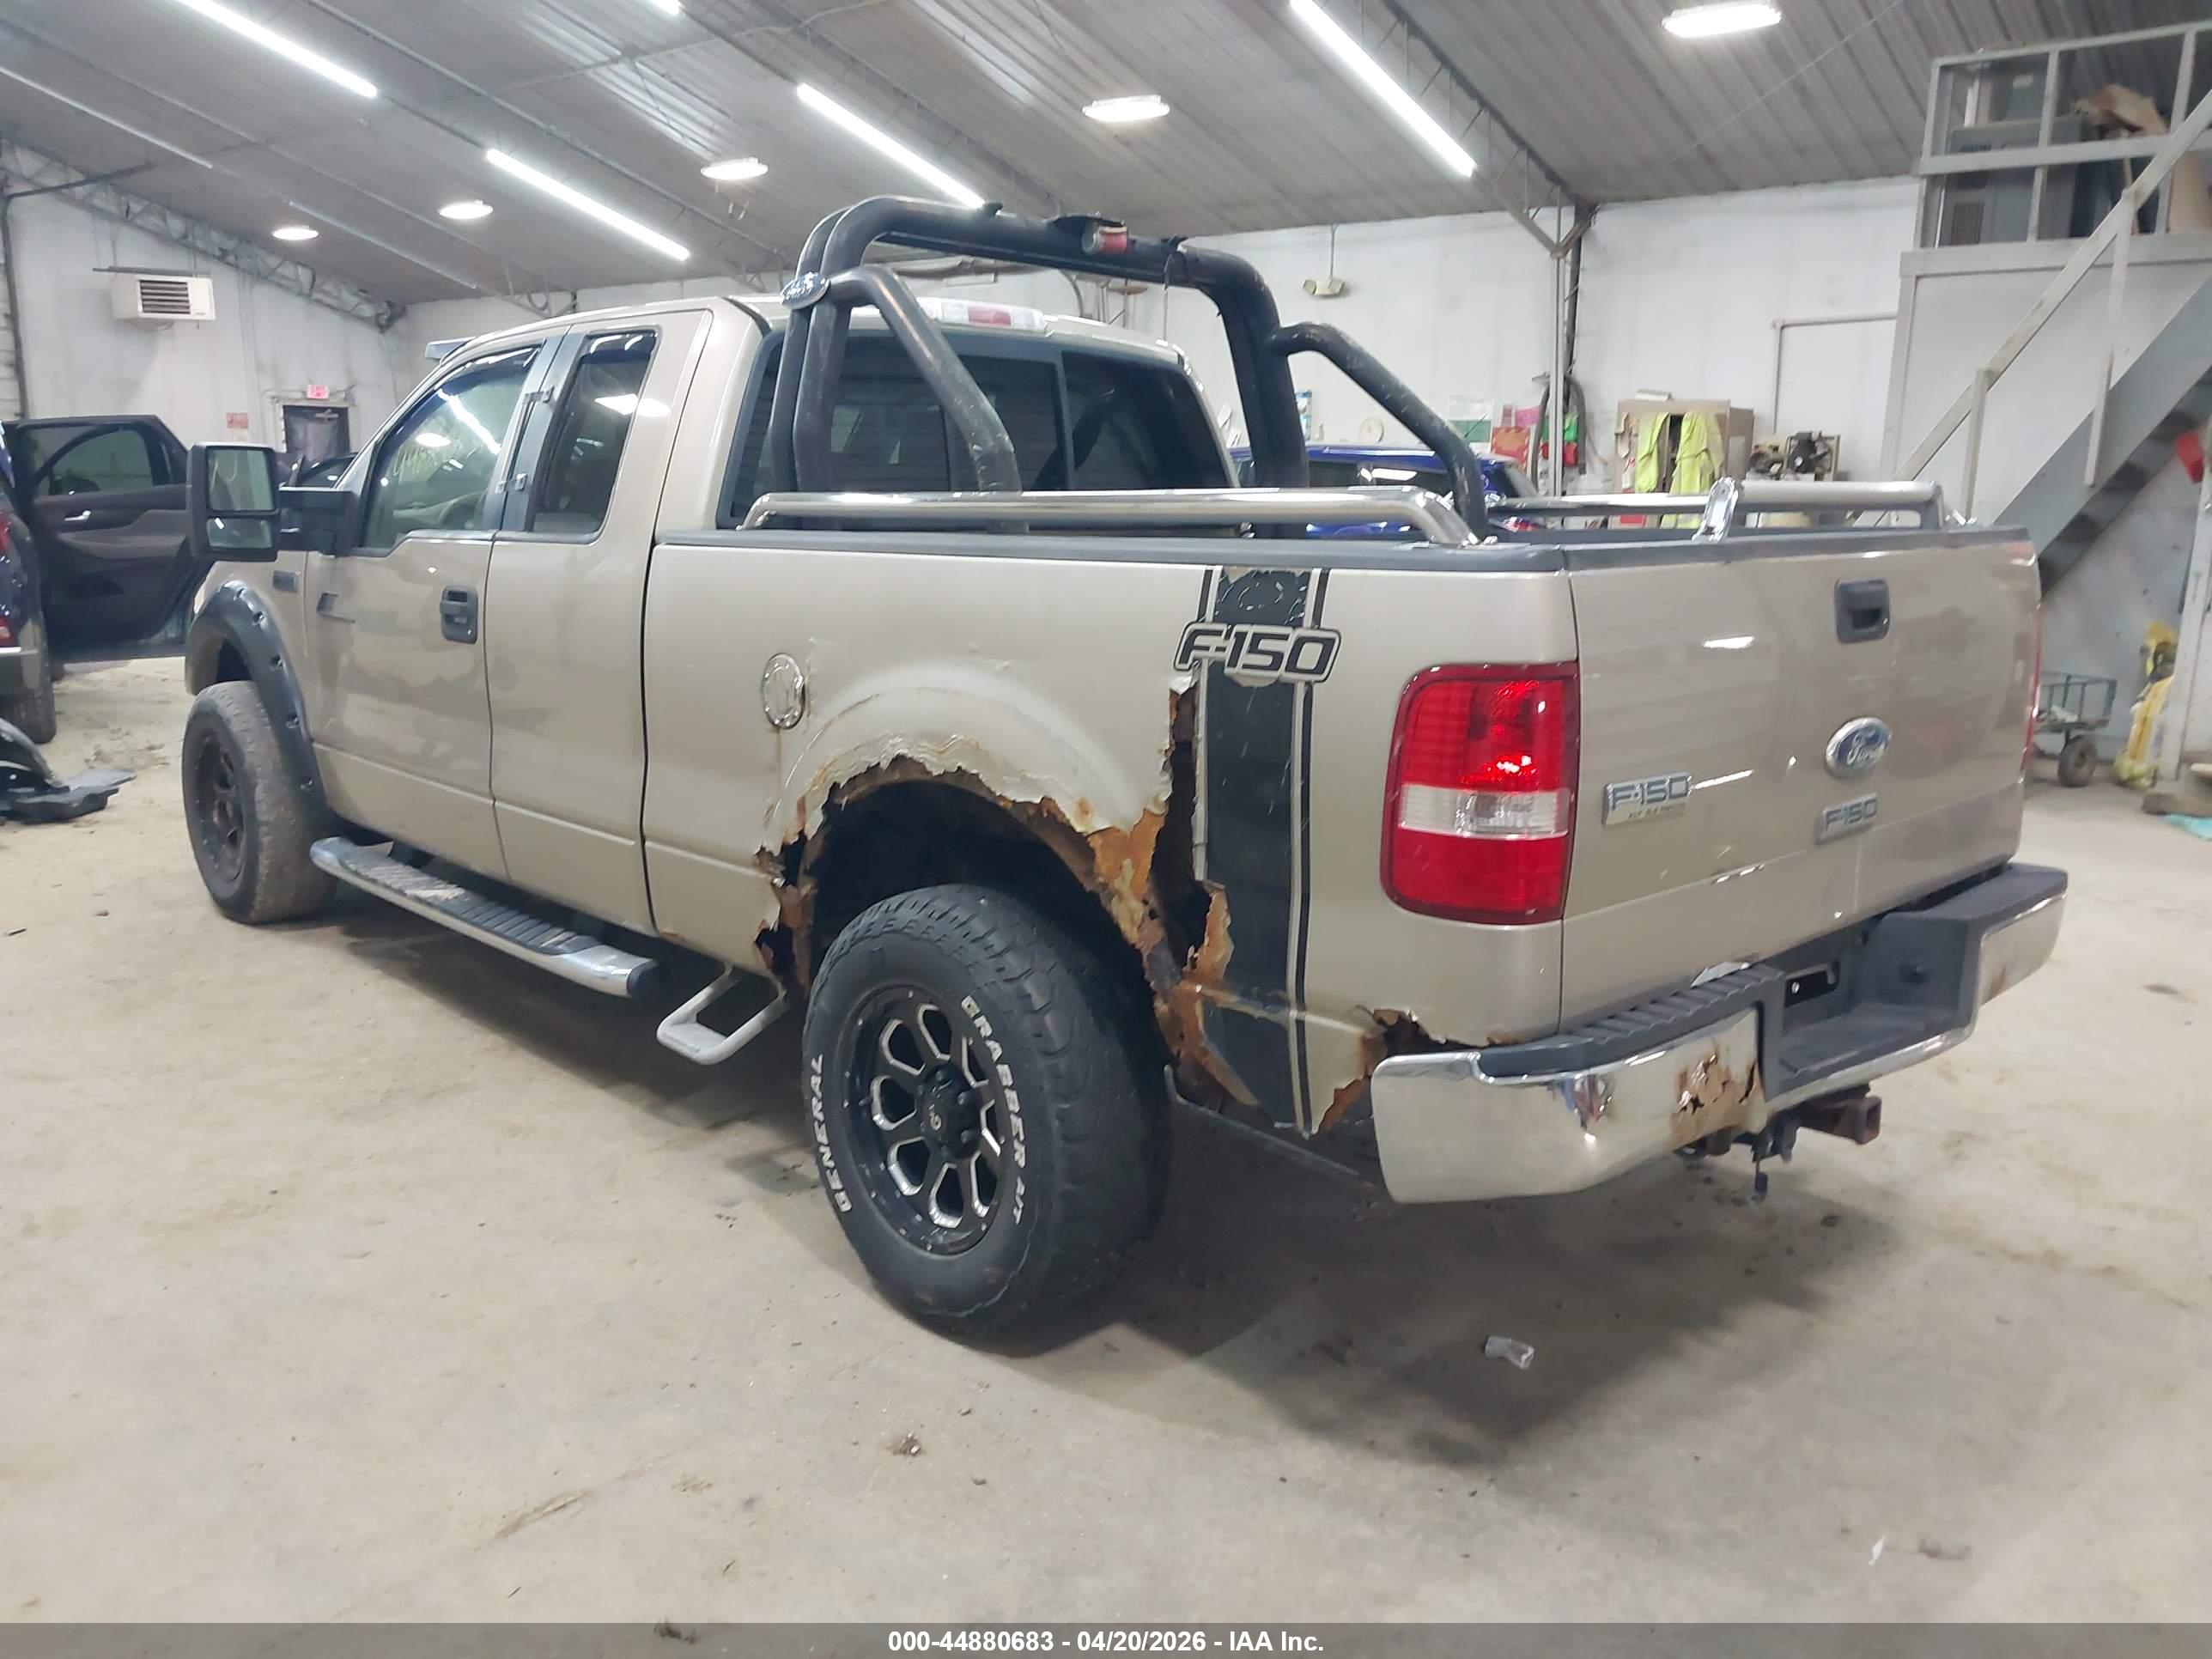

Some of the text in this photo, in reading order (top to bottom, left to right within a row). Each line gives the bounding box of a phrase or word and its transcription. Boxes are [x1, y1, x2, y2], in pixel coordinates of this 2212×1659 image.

[1175, 623, 1340, 681] F-150
[810, 1053, 853, 1212] GENERAL
[961, 994, 1026, 1169] GRABBER
